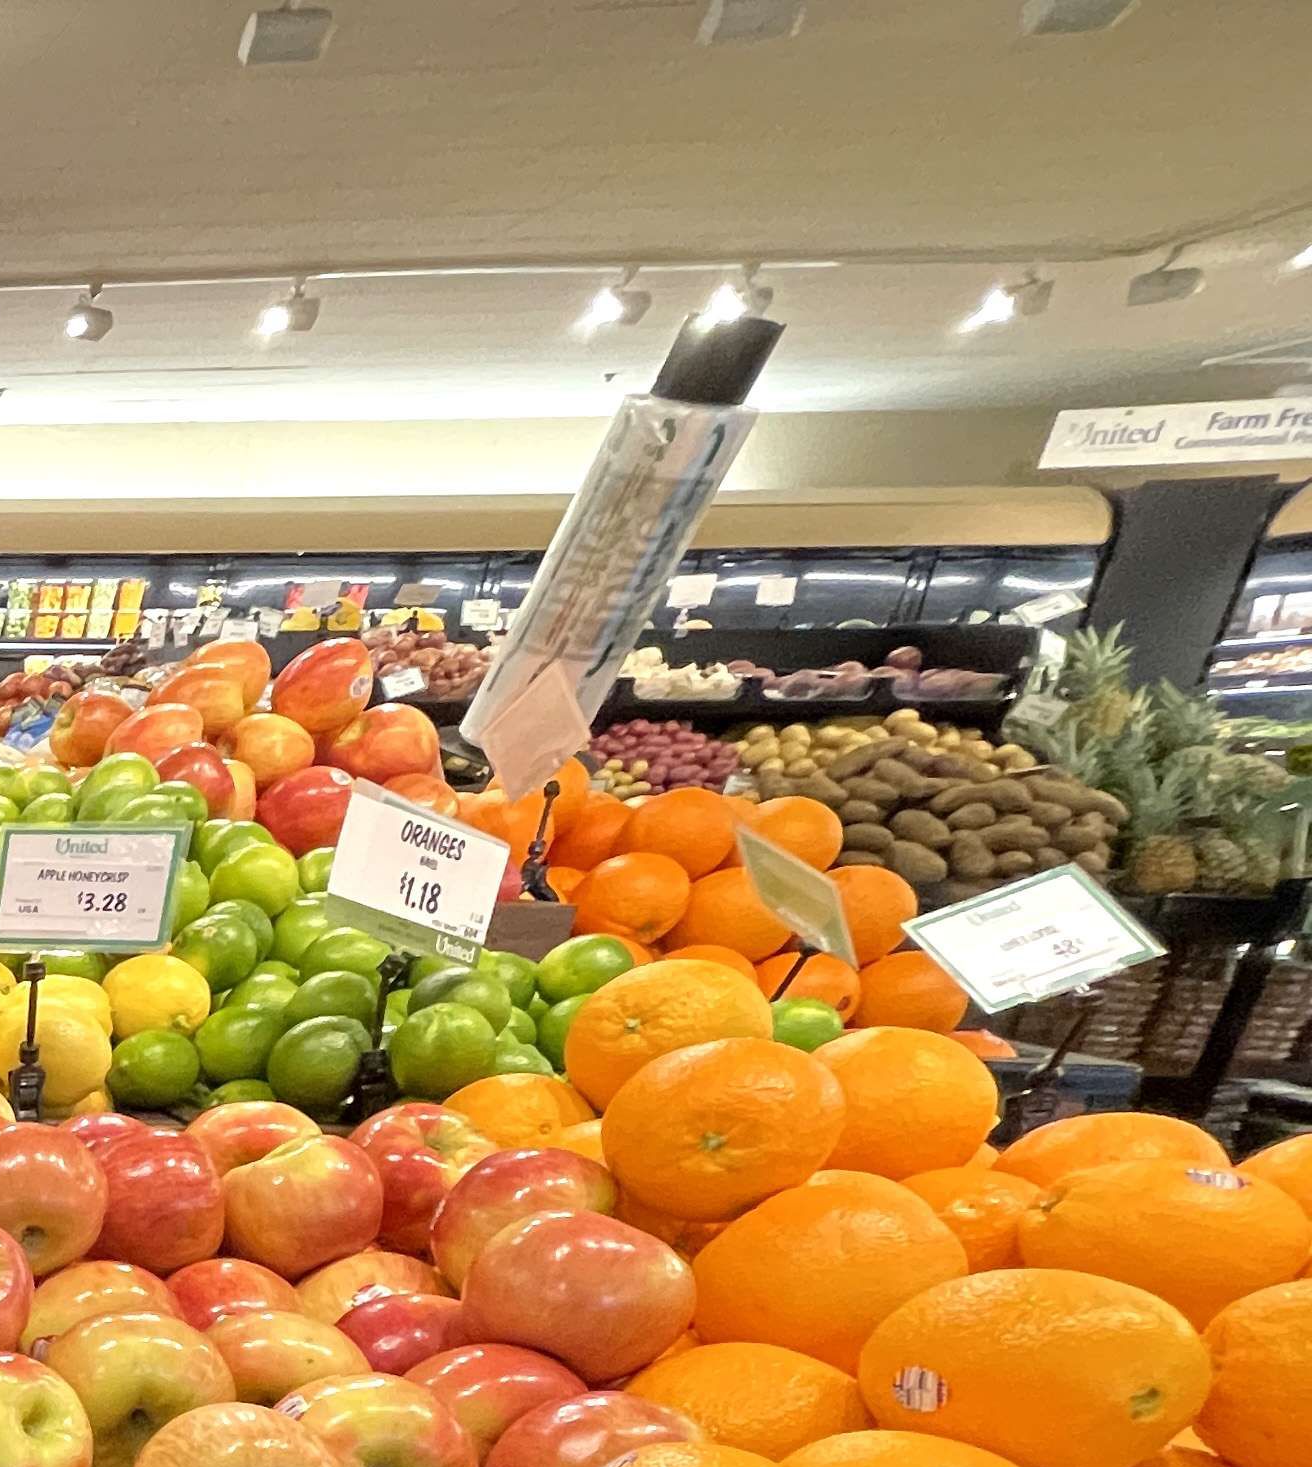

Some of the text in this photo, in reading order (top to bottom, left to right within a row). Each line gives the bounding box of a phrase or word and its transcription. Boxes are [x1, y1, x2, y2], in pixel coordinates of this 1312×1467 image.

[1206, 411, 1272, 431] Farm
[56, 838, 109, 854] United
[400, 820, 466, 860] ORANGES
[37, 868, 130, 884] APPLE HONEYCRISP
[77, 892, 128, 912] $3.28
[399, 871, 442, 915] $1.18
[17, 904, 39, 914] USA
